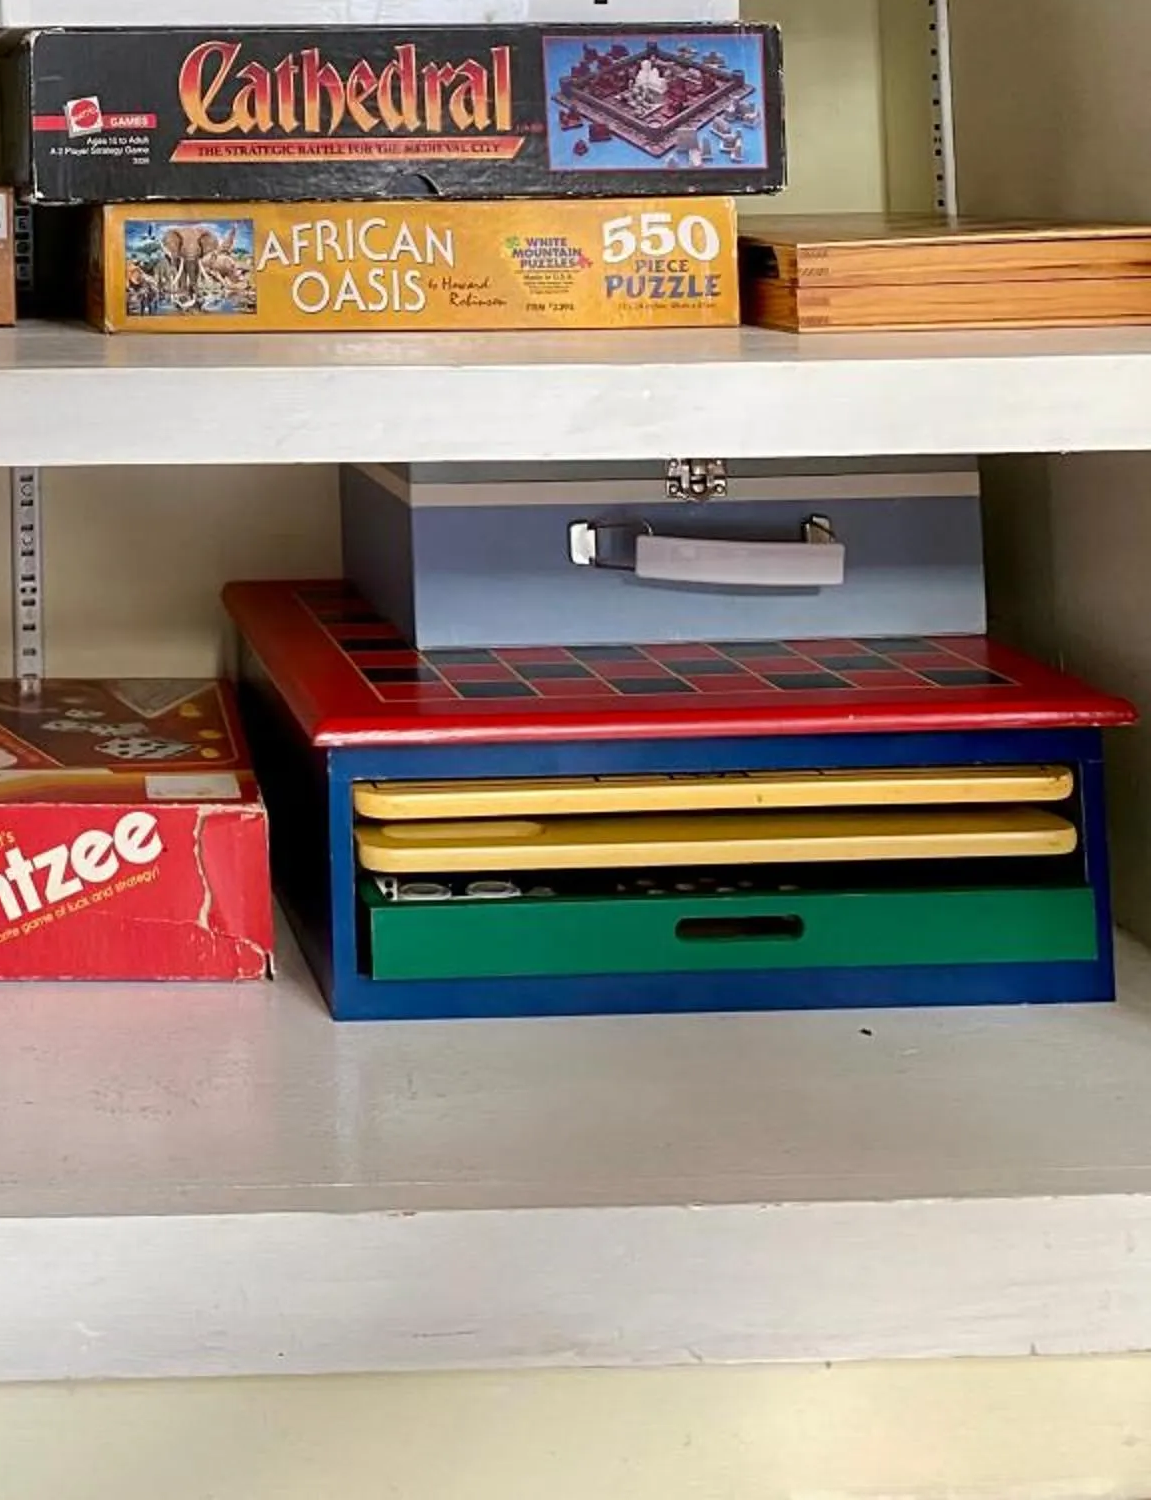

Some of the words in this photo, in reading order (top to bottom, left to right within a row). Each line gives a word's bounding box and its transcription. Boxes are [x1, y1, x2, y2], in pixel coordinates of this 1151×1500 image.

[178, 40, 513, 135] Cathedral
[110, 116, 149, 126] GAMES
[257, 218, 455, 271] AFRICAN
[525, 237, 568, 248] WHITE
[601, 212, 721, 263] 550
[512, 248, 582, 259] MOUNTAIN
[520, 258, 577, 269] PUZZLES
[634, 259, 690, 274] PIECE
[292, 269, 427, 314] OASIS
[441, 278, 489, 291] Howard
[604, 274, 722, 300] PUZZLE
[21, 911, 54, 936] game
[67, 898, 90, 913] luck
[90, 886, 115, 906] and
